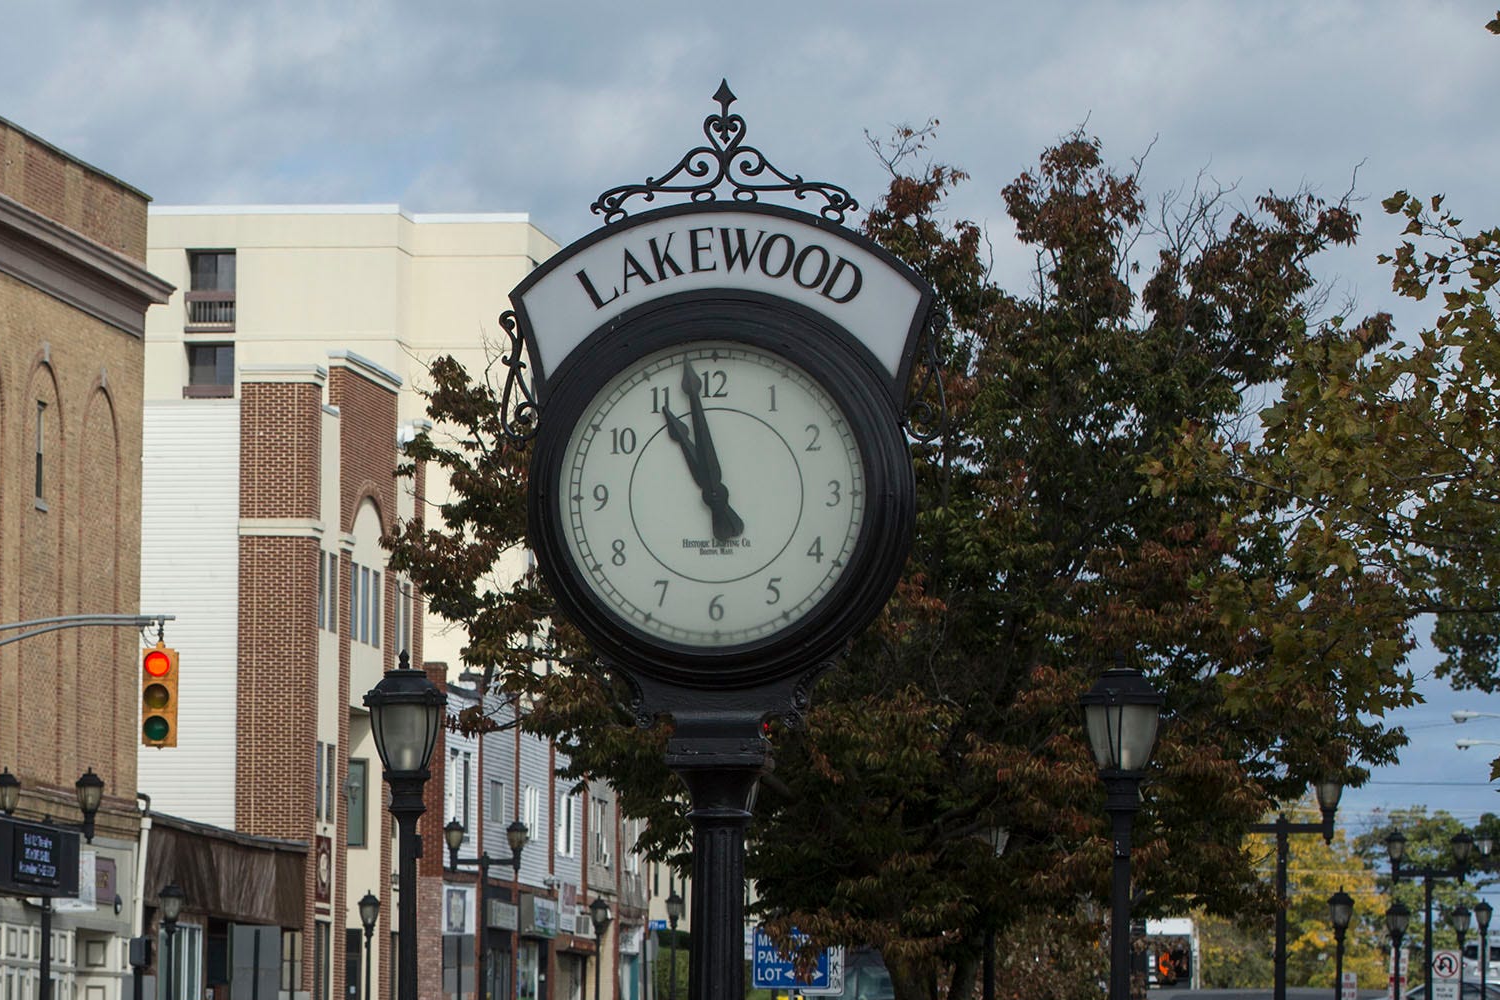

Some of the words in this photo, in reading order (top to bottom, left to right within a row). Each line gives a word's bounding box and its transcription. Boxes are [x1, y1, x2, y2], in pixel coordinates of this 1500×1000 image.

[574, 227, 863, 310] LAKEWOOD
[701, 370, 728, 398] 12
[651, 387, 670, 413] 11
[768, 385, 777, 412] 1
[610, 427, 636, 454] 10
[804, 424, 821, 451] 2
[592, 484, 608, 511] 9
[825, 480, 841, 507] 3
[611, 540, 626, 566] 8
[807, 536, 823, 563] 4
[653, 580, 669, 607] 7
[766, 577, 781, 605] 5
[708, 594, 724, 621] 6
[757, 968, 782, 981] LOT
